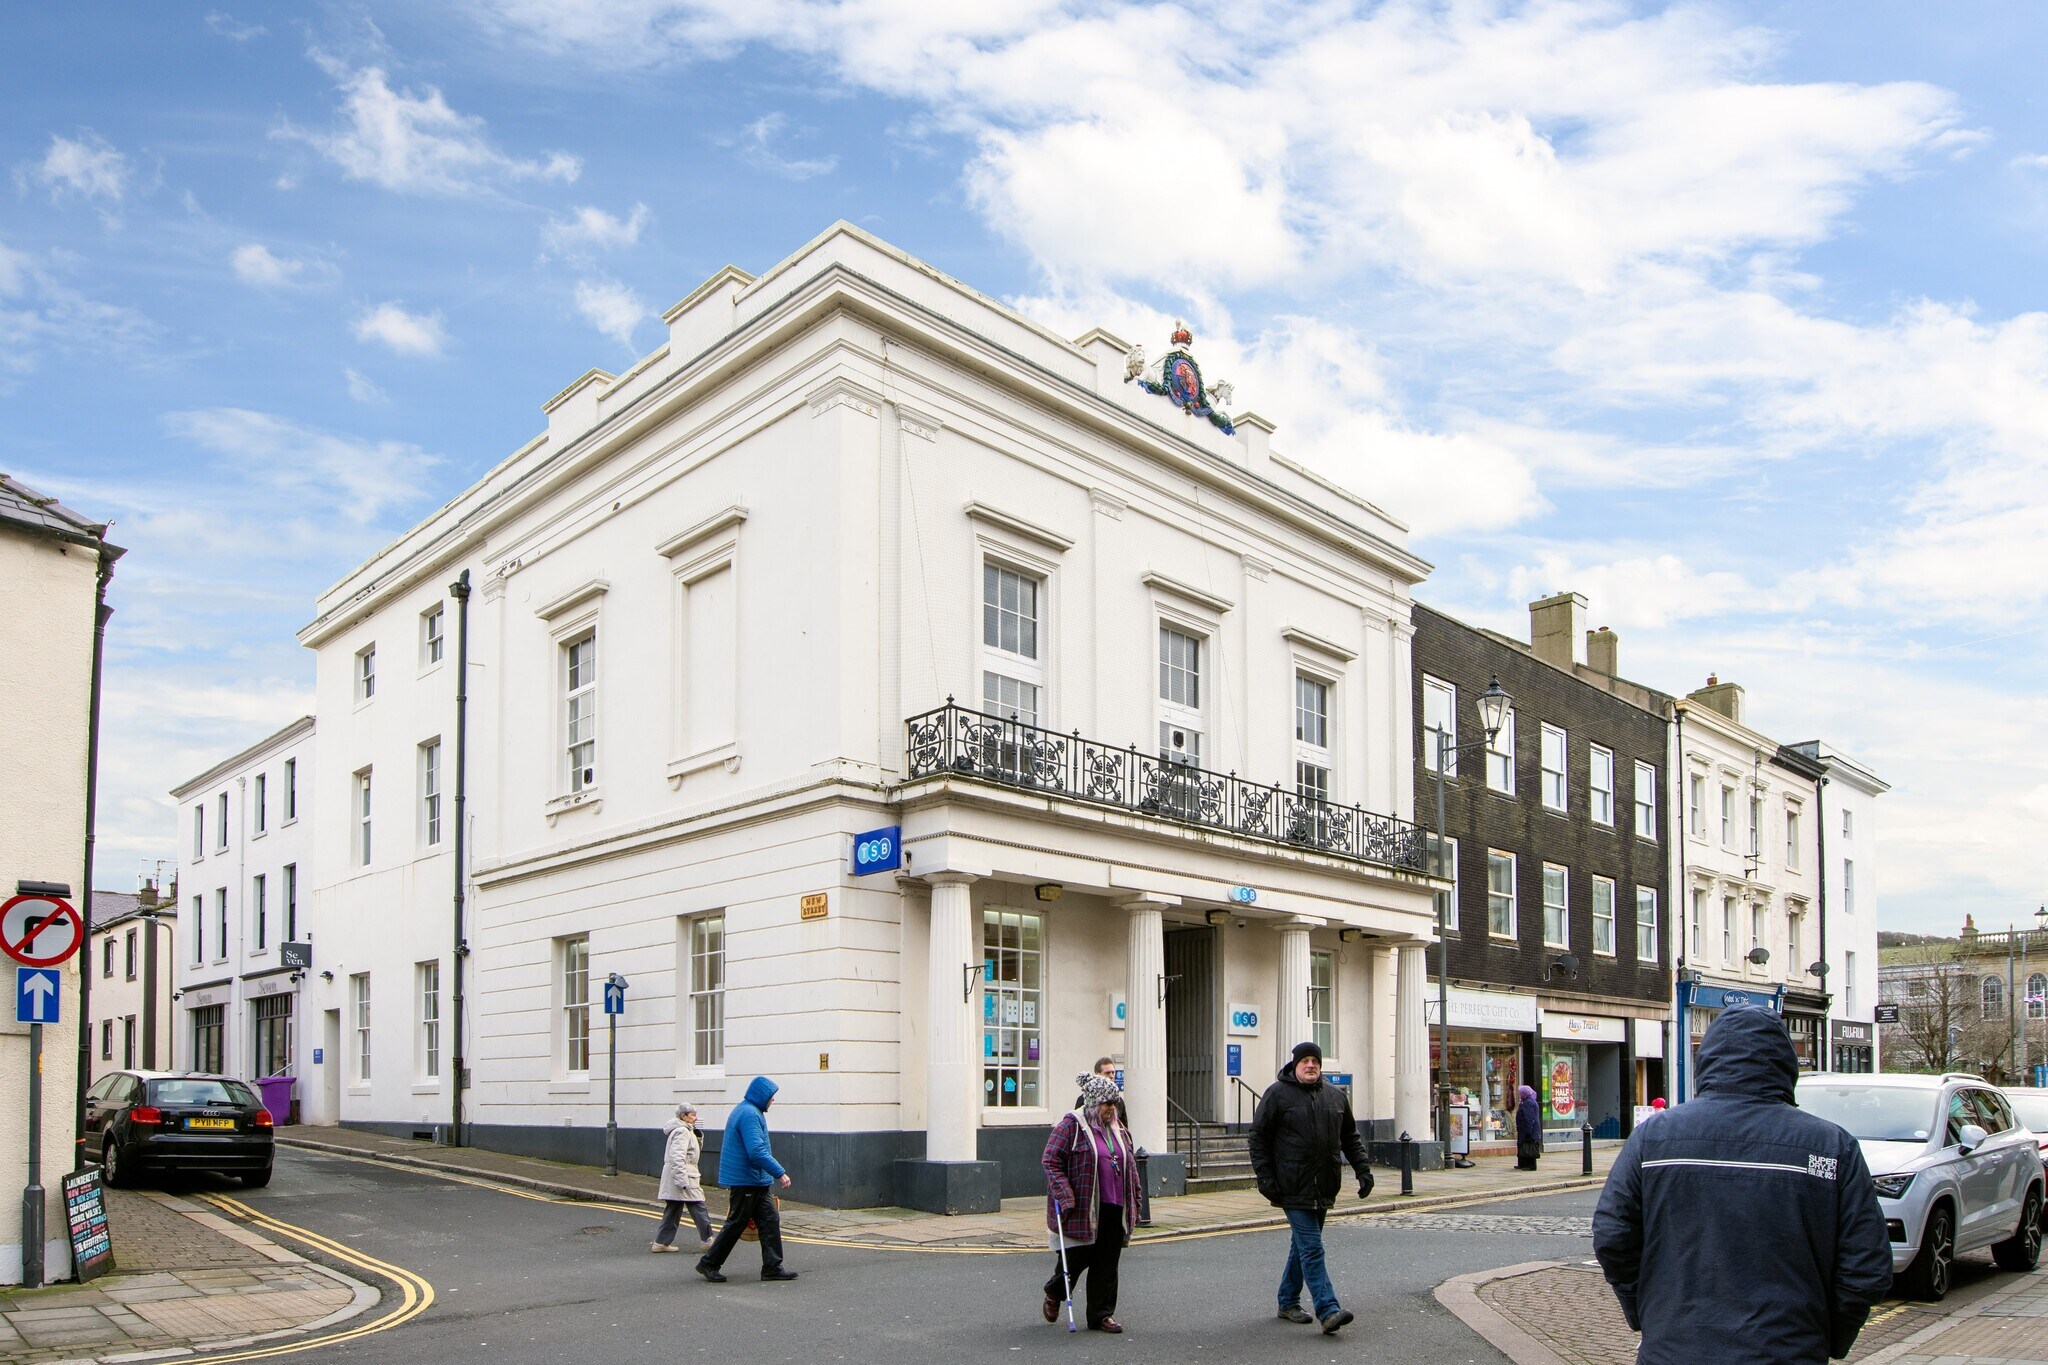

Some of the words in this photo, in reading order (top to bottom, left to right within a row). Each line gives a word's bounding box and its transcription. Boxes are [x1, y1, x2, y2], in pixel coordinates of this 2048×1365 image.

[860, 842, 889, 860] TSB
[806, 896, 822, 906] NEW
[803, 904, 825, 916] STREET
[286, 950, 298, 959] Se
[1447, 1002, 1459, 1014] HE
[1460, 1003, 1490, 1018] PERFECT
[1234, 1014, 1256, 1025] TSB
[1582, 1020, 1600, 1030] Travel
[1842, 1026, 1864, 1038] FUJIFILM
[1556, 1088, 1570, 1096] HALF
[1808, 1154, 1838, 1166] SUPER
